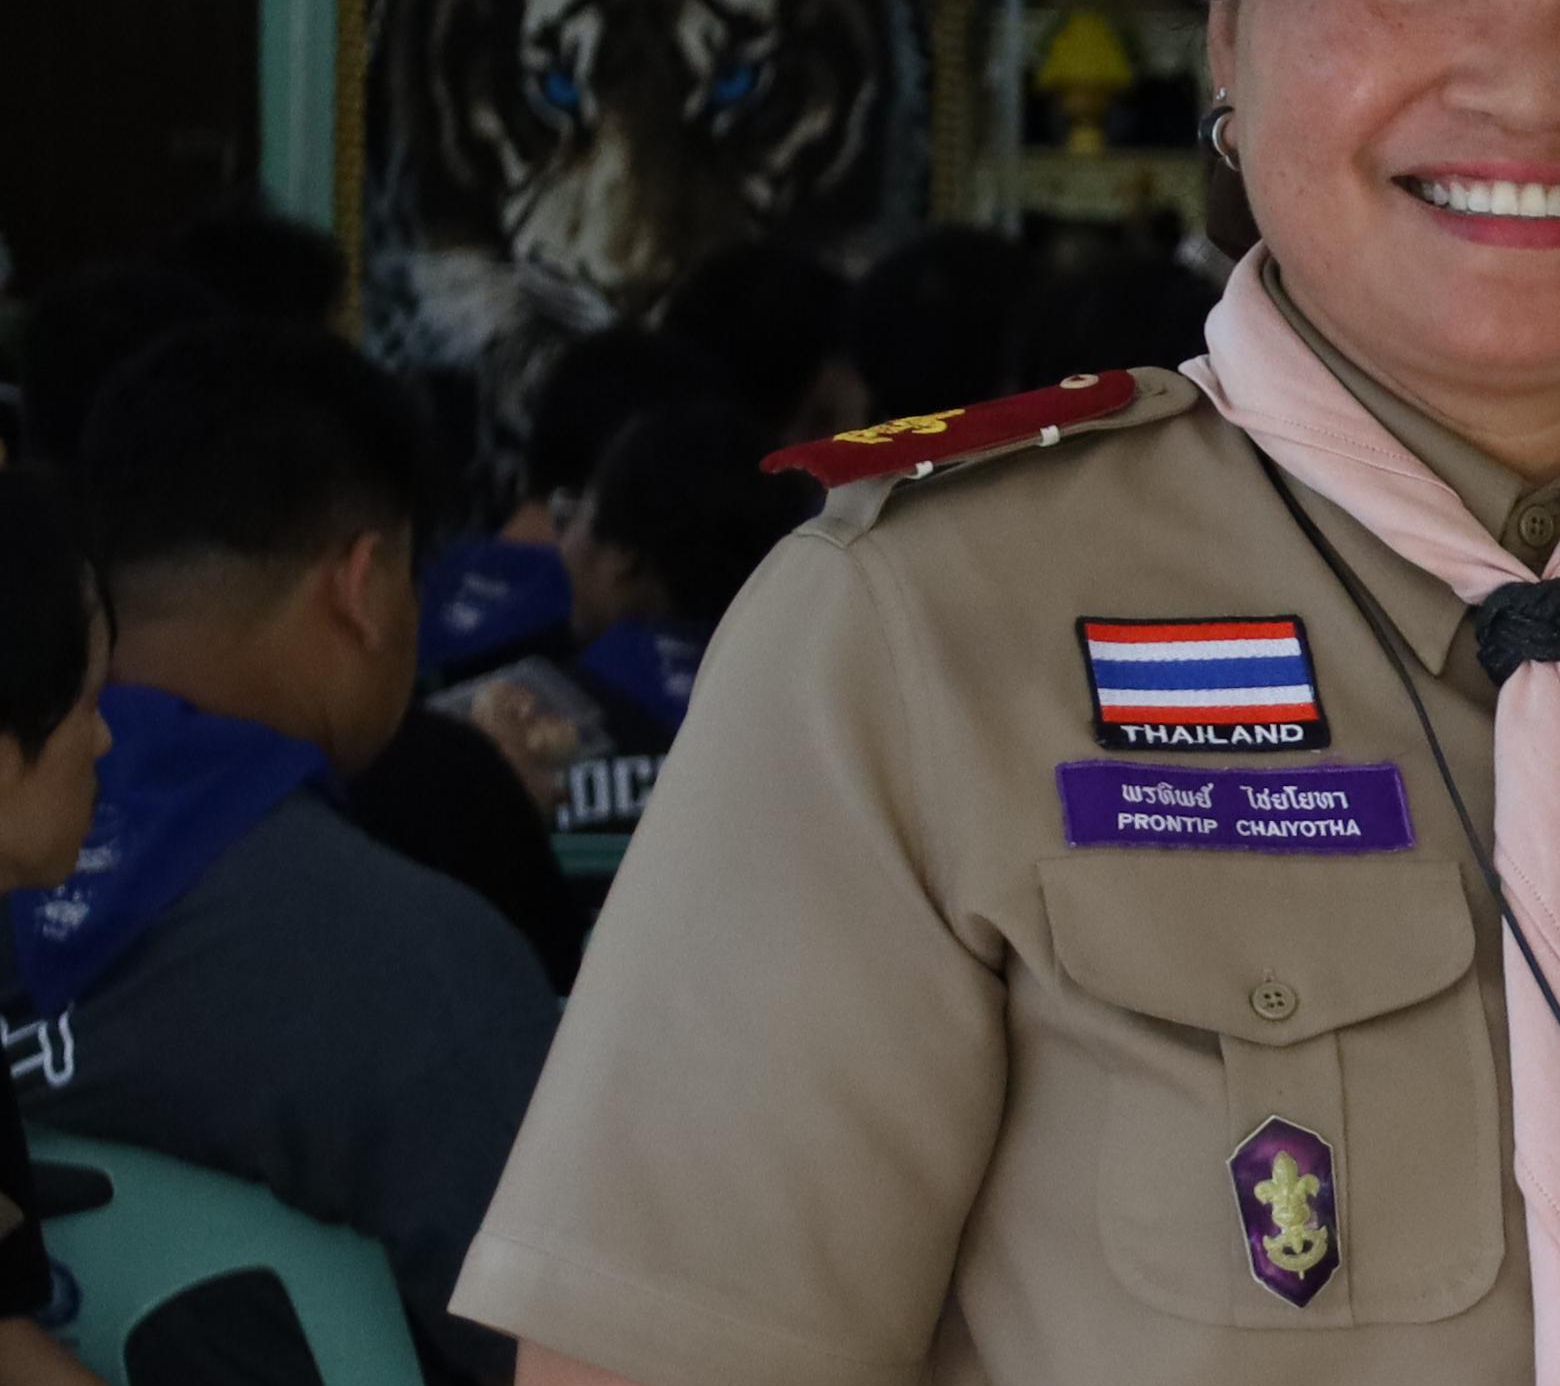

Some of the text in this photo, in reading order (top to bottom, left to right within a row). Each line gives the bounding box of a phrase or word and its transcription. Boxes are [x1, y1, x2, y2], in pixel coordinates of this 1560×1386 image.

[1120, 723, 1305, 745] THAILAND
[1117, 812, 1361, 837] PRONTIP CHAIYOTHA
